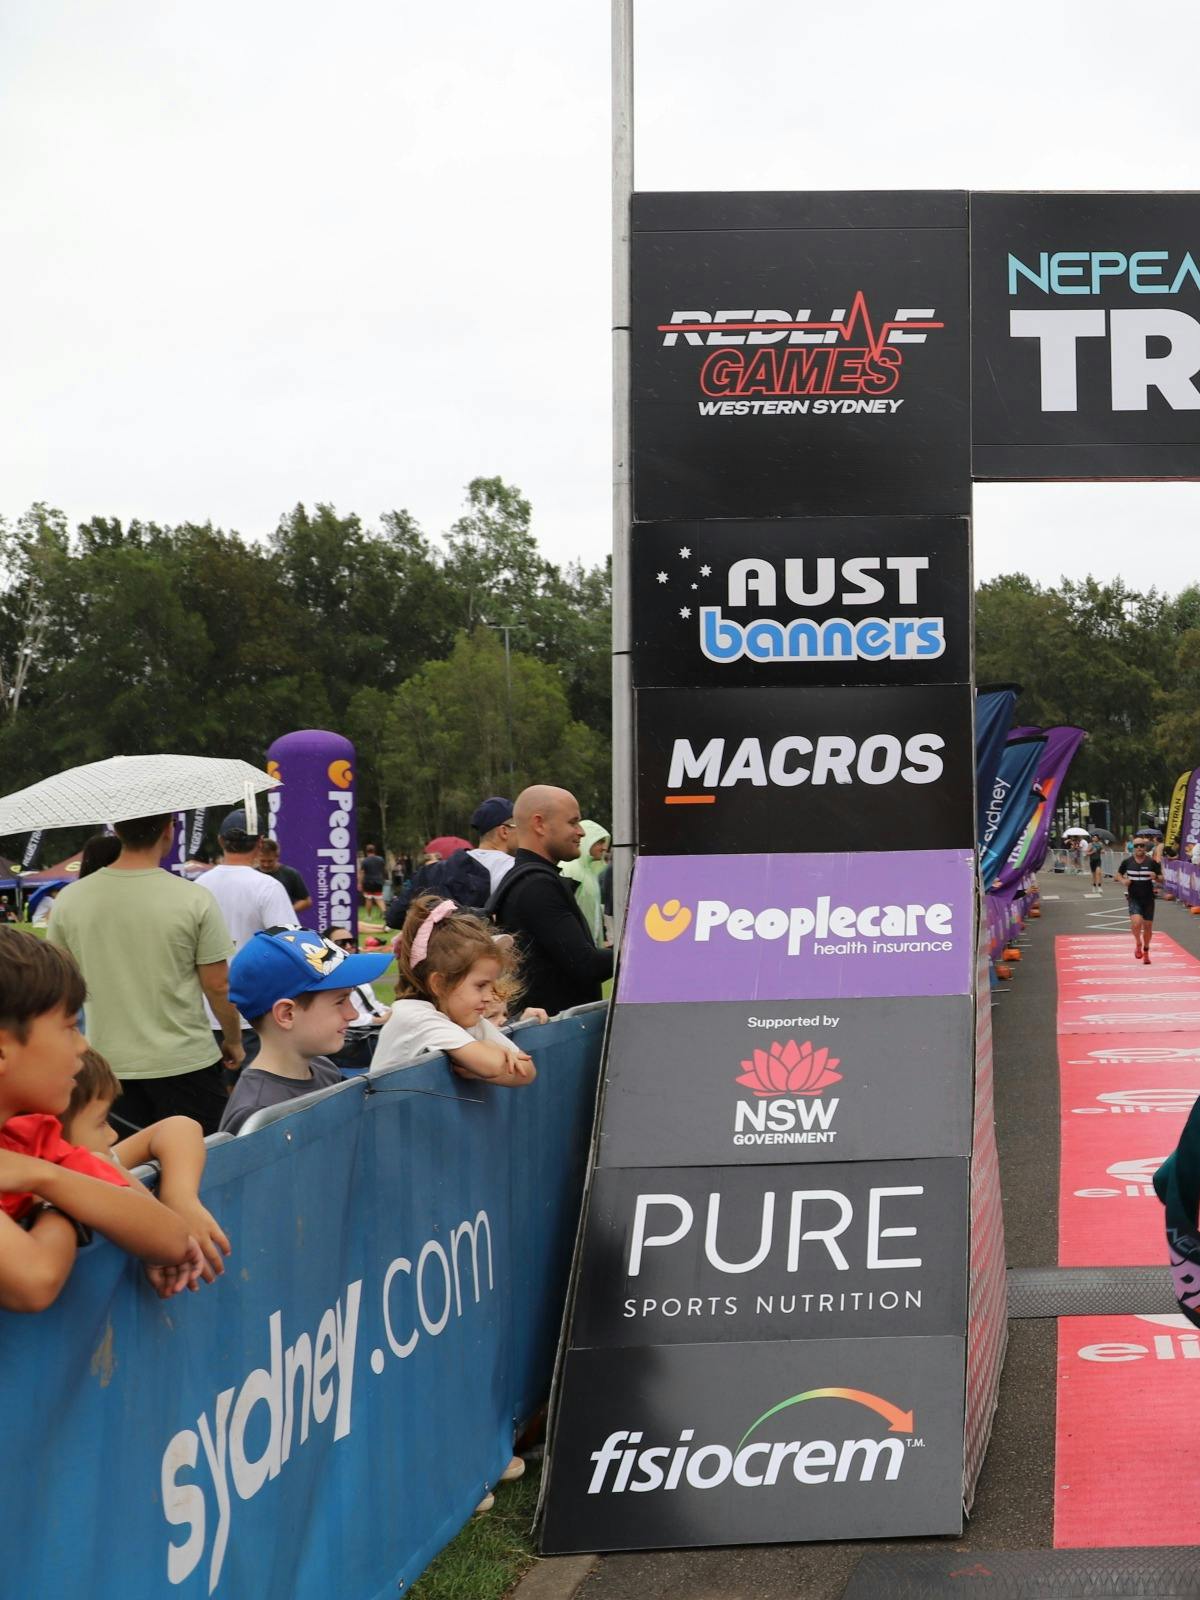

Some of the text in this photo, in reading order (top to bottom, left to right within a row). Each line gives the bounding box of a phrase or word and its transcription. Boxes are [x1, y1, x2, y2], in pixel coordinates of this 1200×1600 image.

[700, 346, 902, 397] GAMES
[698, 399, 904, 416] WESTERN SYDNEY
[728, 556, 929, 607] AUST
[699, 606, 946, 664] banners
[667, 733, 946, 788] MACROS
[317, 865, 330, 898] health
[694, 895, 953, 956] Peoplecare
[813, 939, 953, 956] health insurance
[747, 1014, 840, 1030] Supported by
[733, 1131, 837, 1146] GOVERNMENT
[734, 1098, 840, 1132] NSW
[628, 1186, 925, 1277] PURE
[623, 1290, 922, 1318] SPORTS NUTRITION
[161, 1210, 494, 1597] sydney.com
[586, 1428, 906, 1495] fisiocrem
